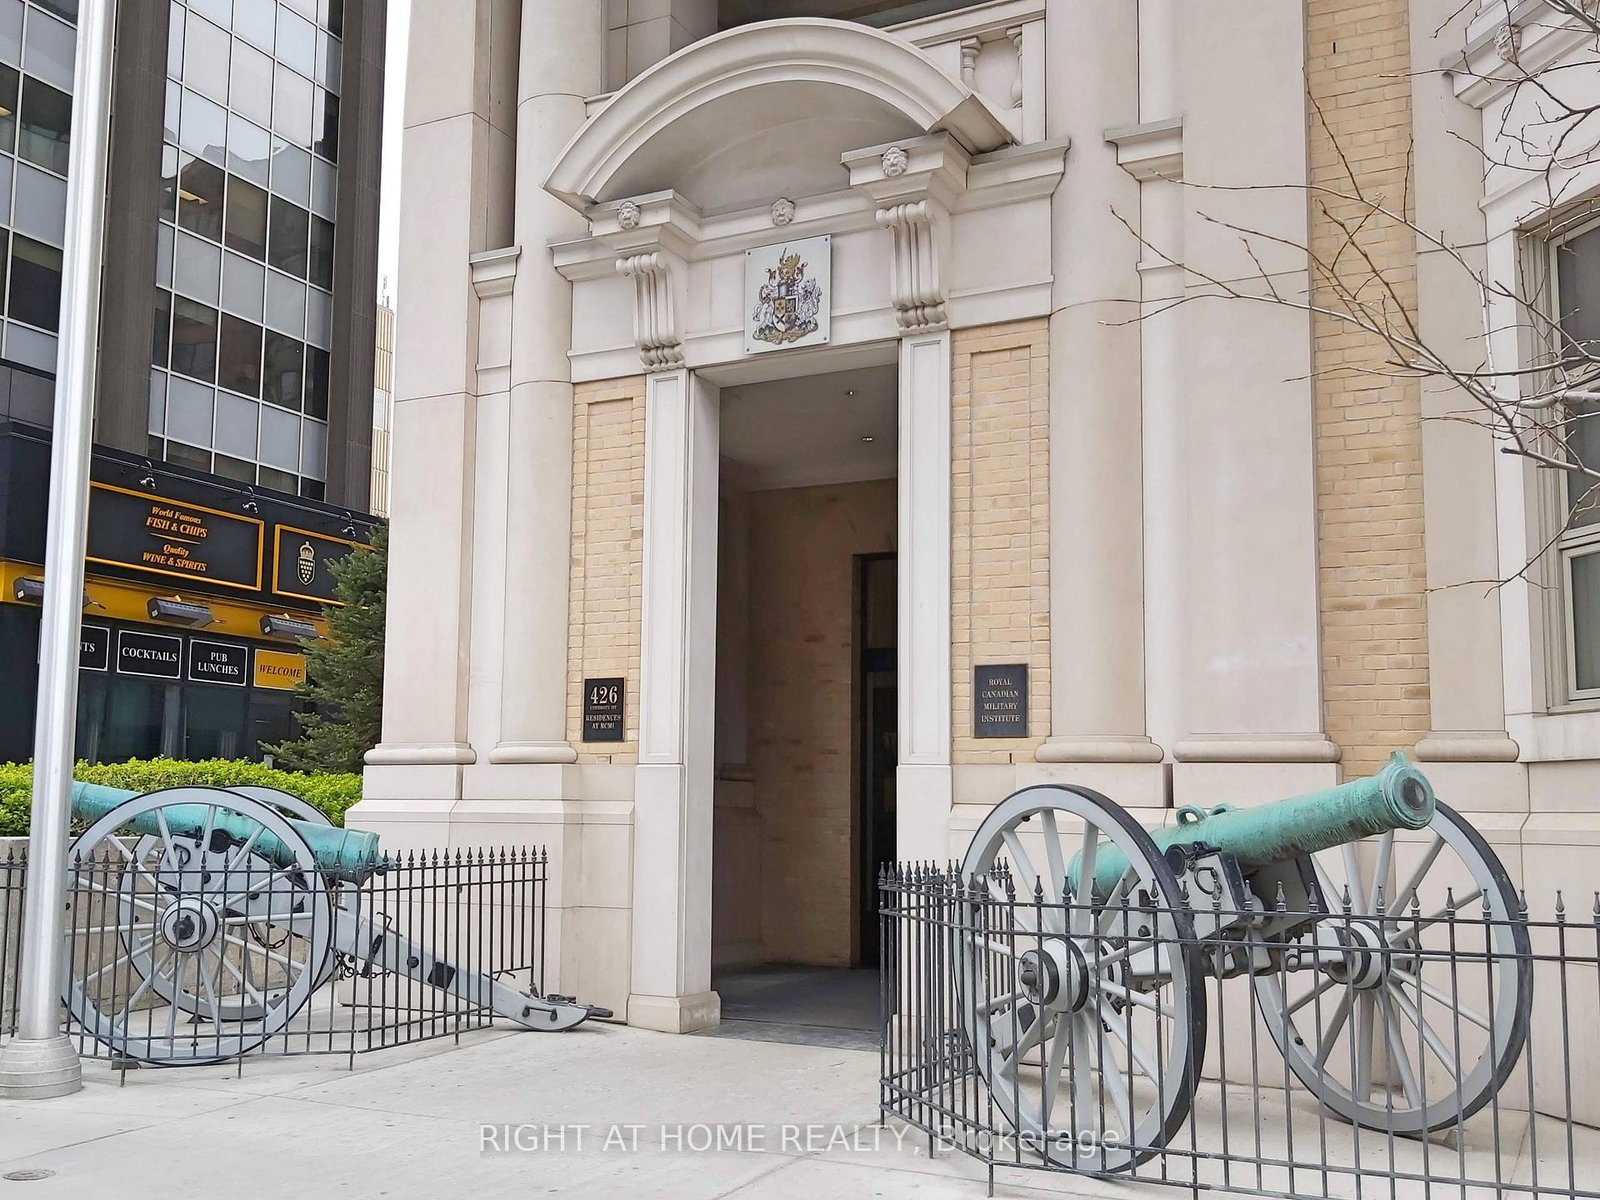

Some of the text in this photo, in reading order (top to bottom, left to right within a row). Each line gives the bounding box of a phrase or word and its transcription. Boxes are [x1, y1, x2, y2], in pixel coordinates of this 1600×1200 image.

[151, 506, 202, 524] World Famous
[145, 516, 208, 538] FISH & CHIPS
[163, 544, 189, 557] Quality
[142, 552, 207, 572] WINE & SPIRITS
[122, 646, 178, 662] COCKTAILS
[210, 651, 228, 662] PUB
[197, 661, 240, 676] LUNCHES
[259, 664, 302, 678] WELCOME
[988, 678, 1013, 686] ROYAL
[590, 686, 618, 704] 426
[981, 690, 1019, 699] CANADIAN
[983, 702, 1018, 710] MILITARY
[981, 714, 1021, 723] INSTITUTE
